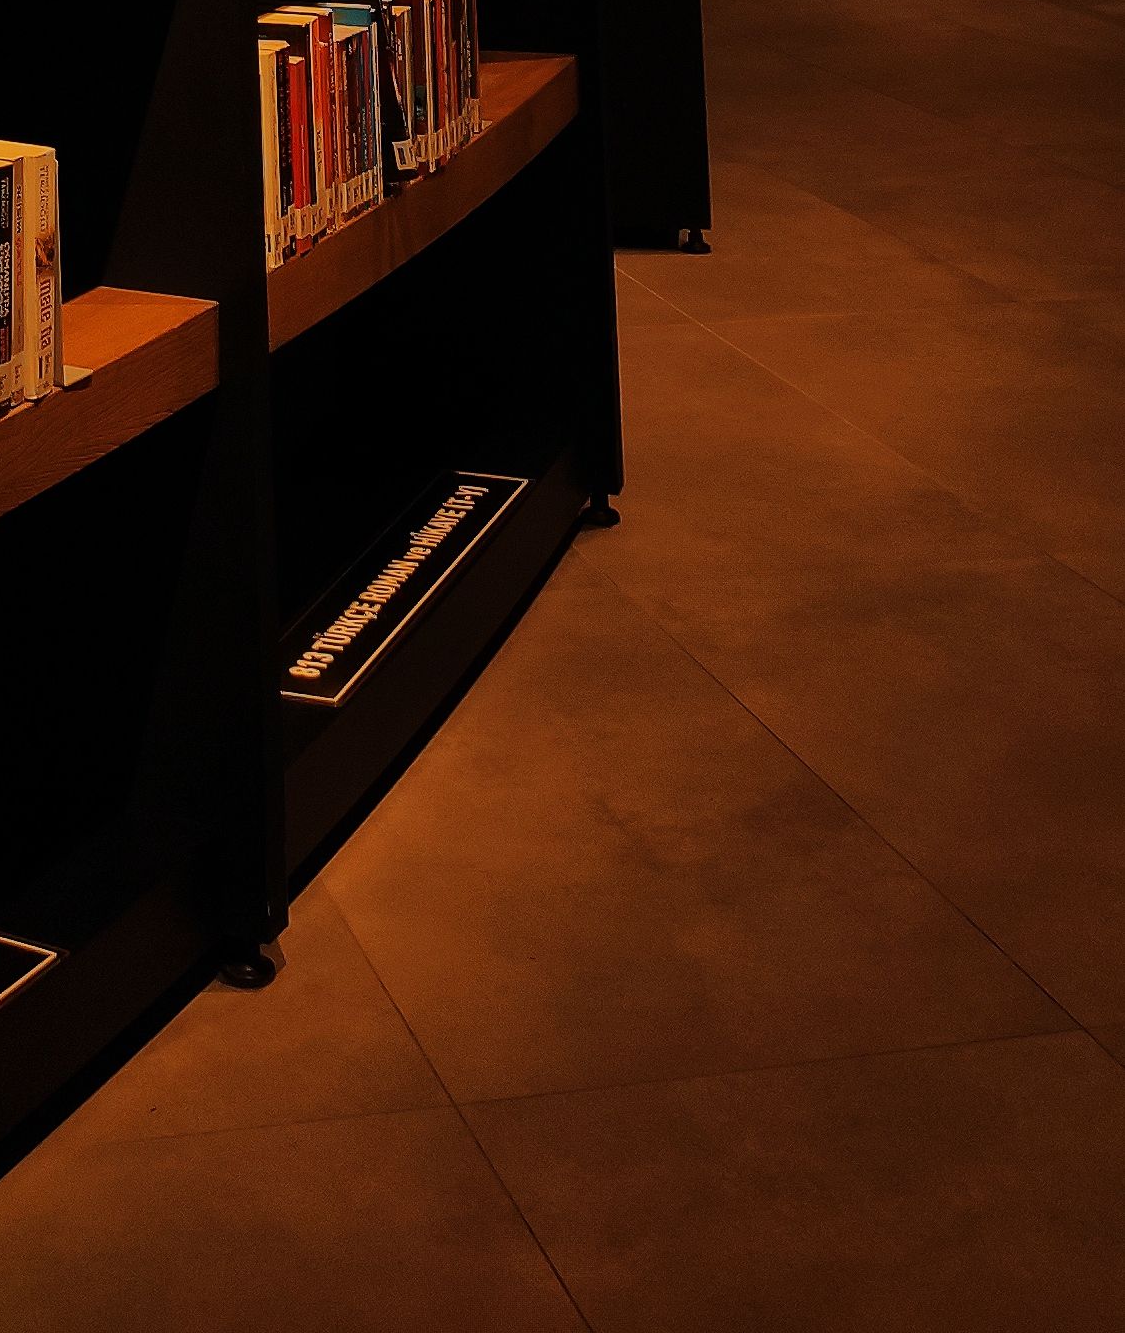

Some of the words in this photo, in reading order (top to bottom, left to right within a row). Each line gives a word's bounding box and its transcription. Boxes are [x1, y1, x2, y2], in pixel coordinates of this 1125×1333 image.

[410, 508, 466, 548] HİKAYE
[404, 547, 431, 561] ve
[359, 560, 419, 603] ROMAN
[312, 602, 382, 651] TÜRKÇE
[289, 652, 334, 679] 813
